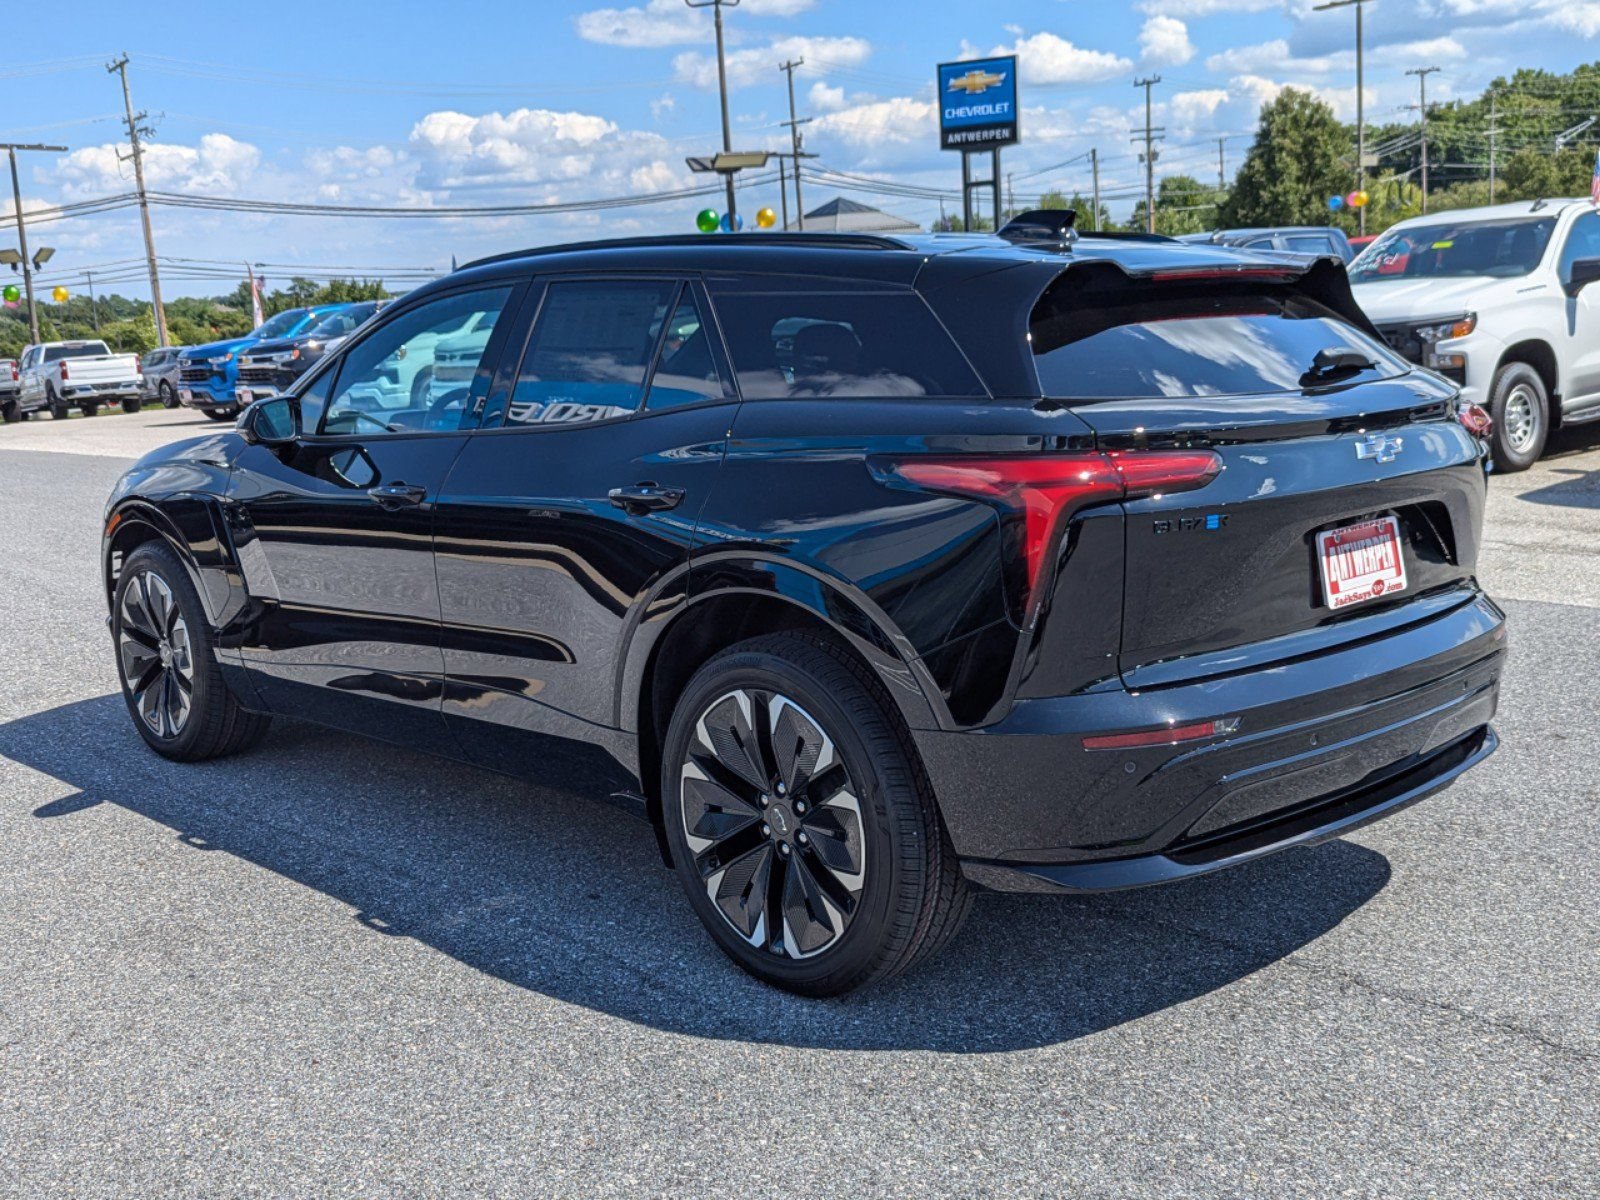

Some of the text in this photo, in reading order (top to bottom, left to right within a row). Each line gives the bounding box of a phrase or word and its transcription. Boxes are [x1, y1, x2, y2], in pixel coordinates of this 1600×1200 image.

[945, 102, 1009, 119] CHEVROLET
[948, 129, 1009, 144] ANTWERPEN
[1328, 534, 1395, 582] ANTWERPEN
